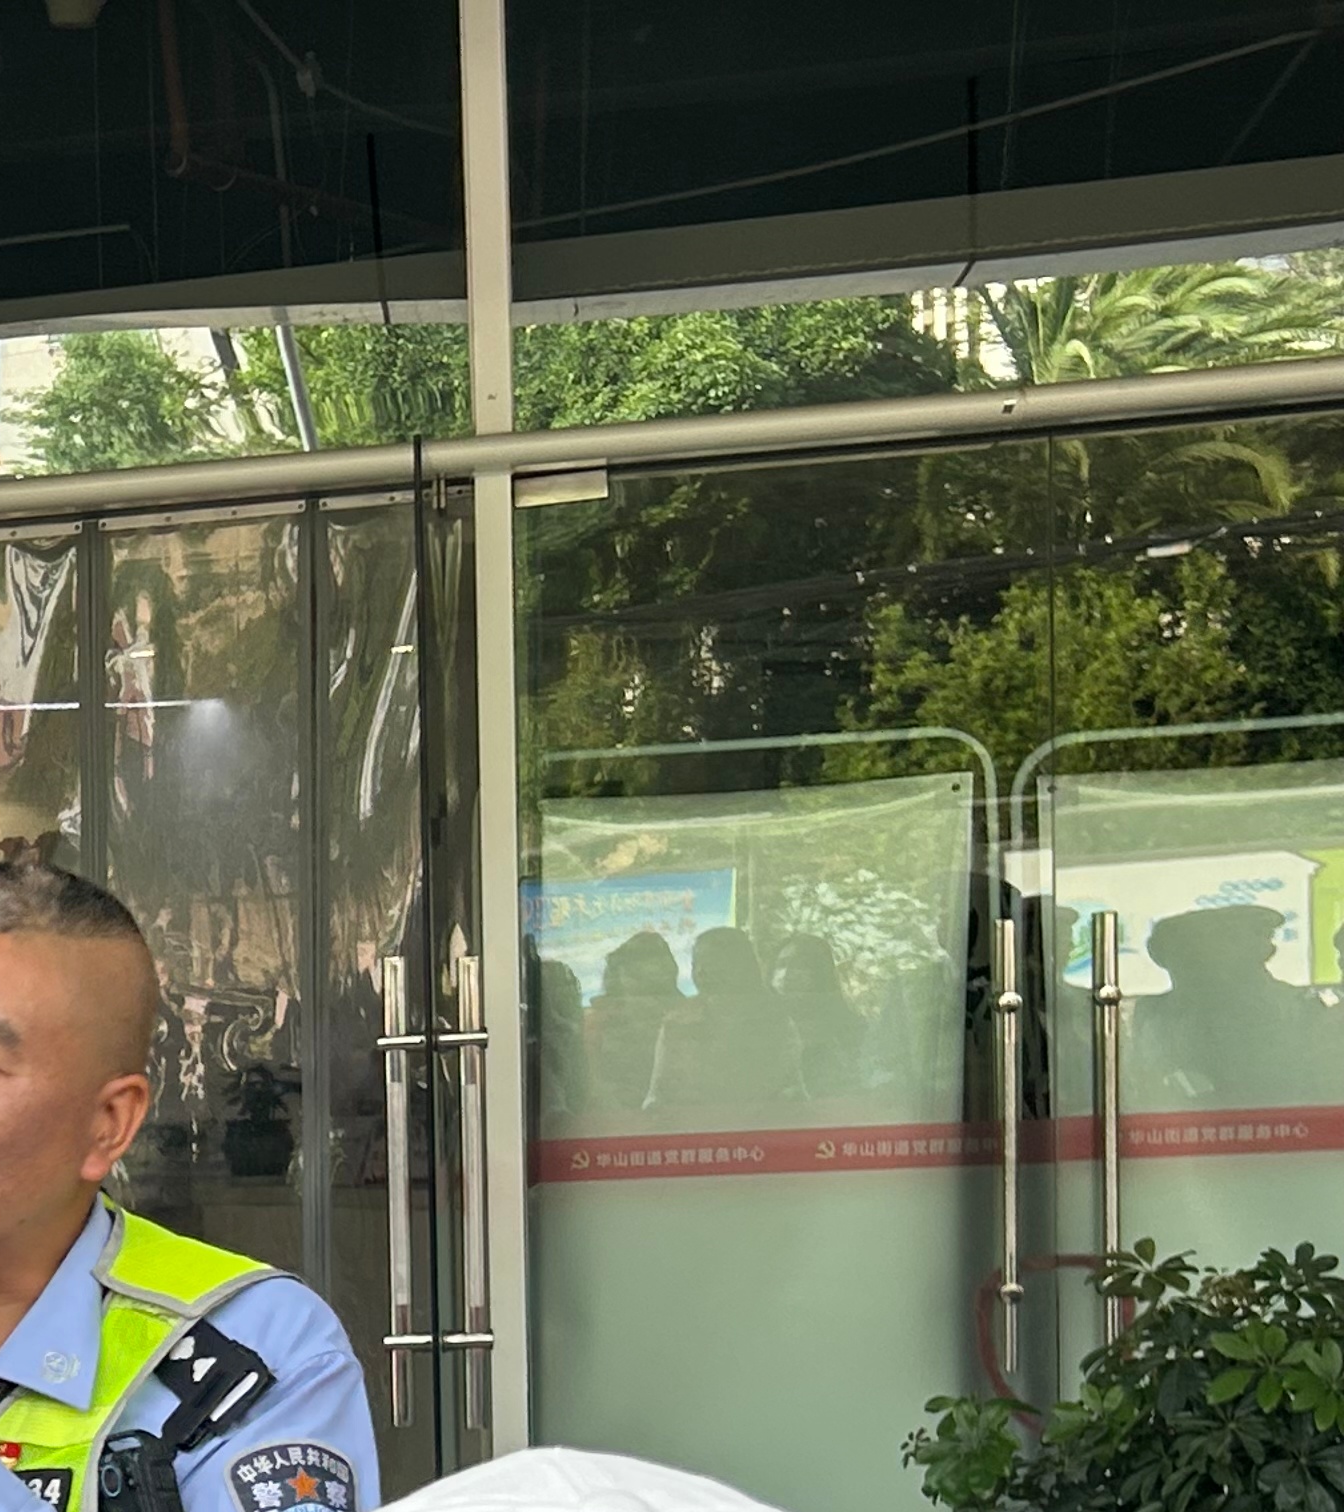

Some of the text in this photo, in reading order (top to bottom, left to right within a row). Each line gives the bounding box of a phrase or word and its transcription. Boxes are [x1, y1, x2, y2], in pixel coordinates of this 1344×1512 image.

[237, 1446, 350, 1484] 中华人民共和国
[251, 1480, 348, 1509] 警察
